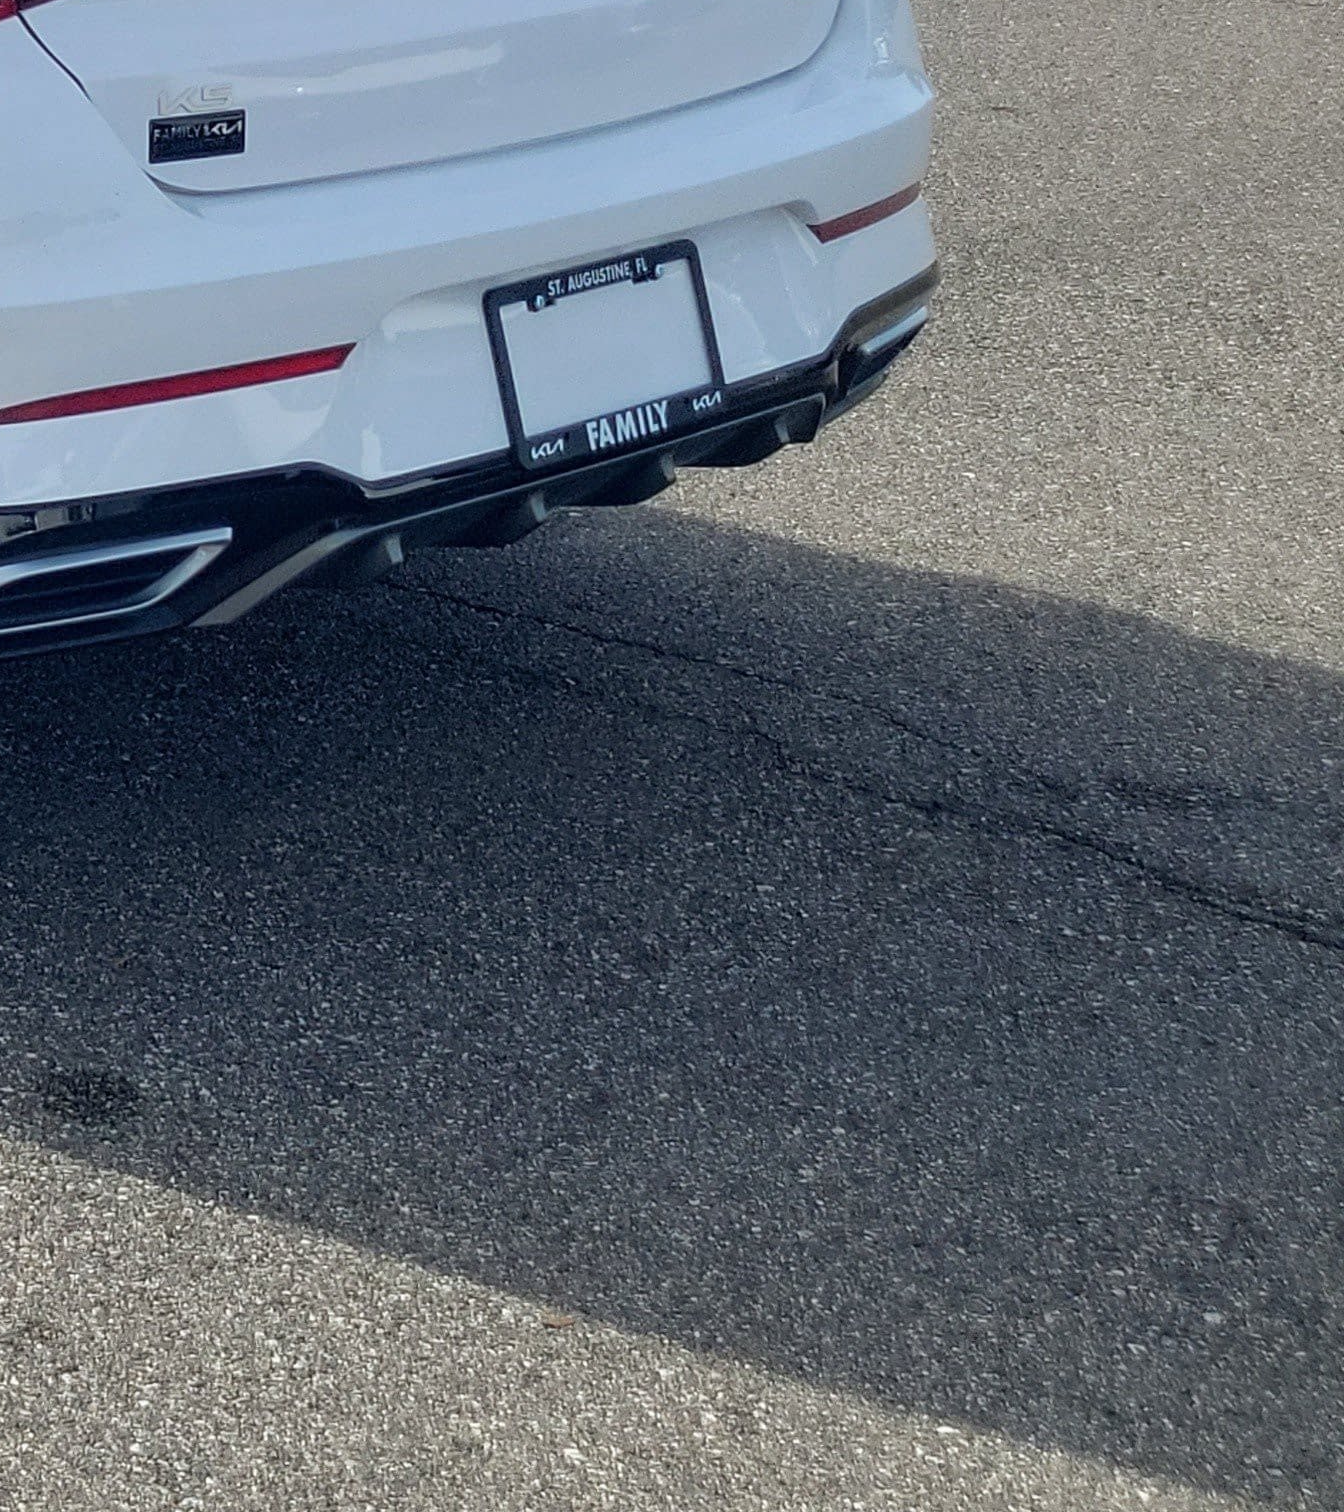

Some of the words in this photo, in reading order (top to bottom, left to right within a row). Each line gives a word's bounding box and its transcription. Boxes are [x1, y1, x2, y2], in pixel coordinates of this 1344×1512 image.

[157, 84, 233, 116] K5
[548, 280, 566, 297] ST.
[635, 256, 649, 275] FL
[585, 400, 669, 452] FAMILY
